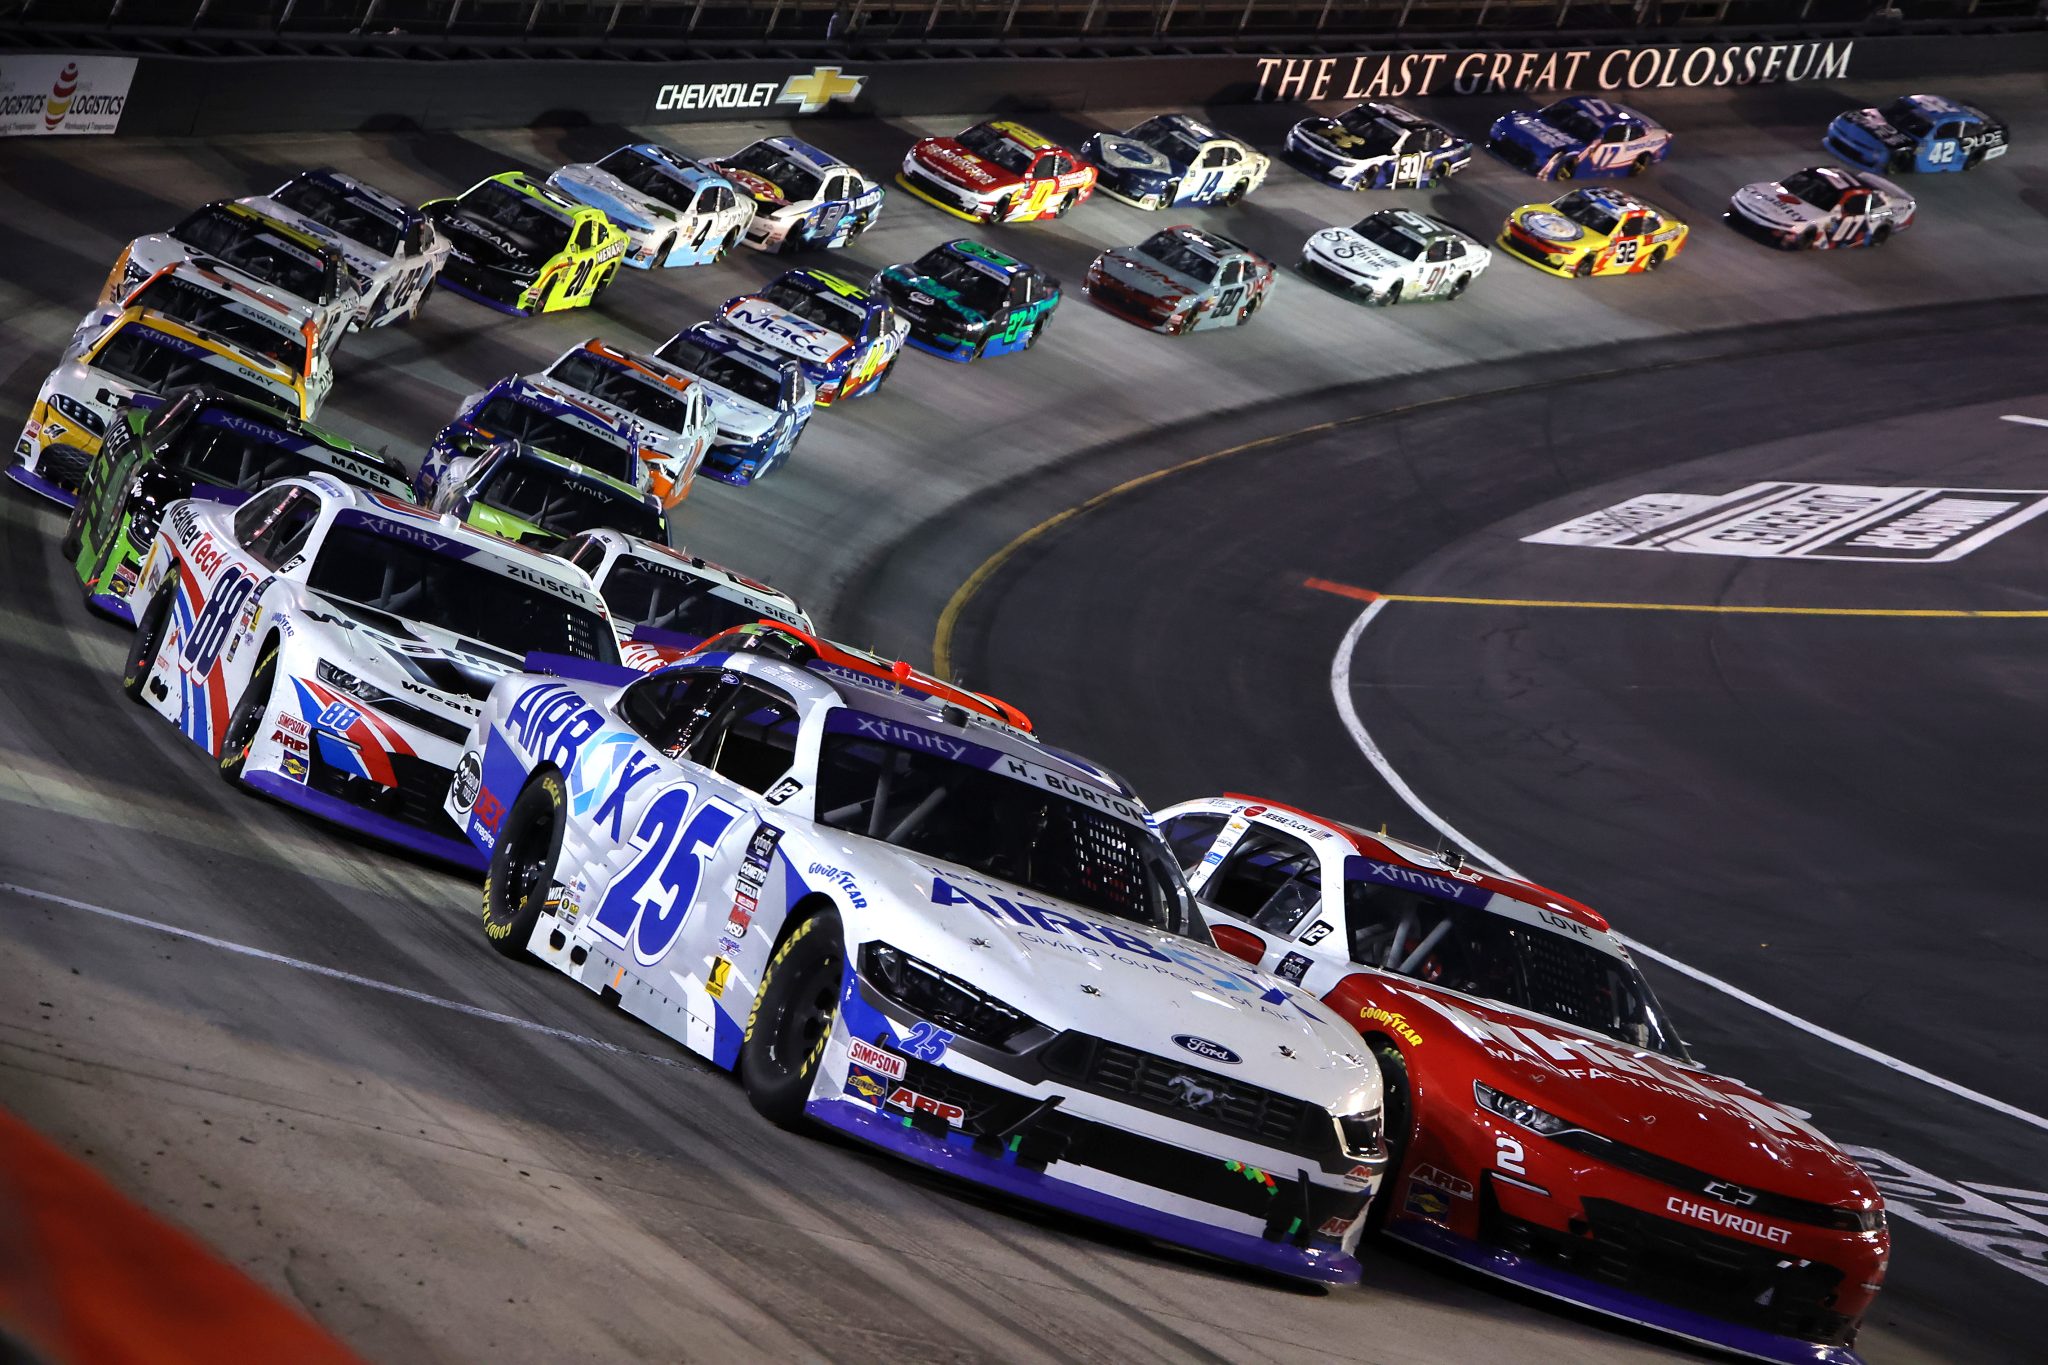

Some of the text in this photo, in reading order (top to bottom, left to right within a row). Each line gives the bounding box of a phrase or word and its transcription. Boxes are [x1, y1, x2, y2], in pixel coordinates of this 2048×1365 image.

[1254, 41, 1855, 103] THE LAST GREAT COLOSSEUM
[0, 95, 46, 115] OGISTICS
[69, 96, 124, 115] LOGISTICS
[656, 82, 778, 111] CHEVROLET
[1399, 153, 1421, 180] 31
[1597, 146, 1620, 167] 17
[1928, 141, 1956, 163] 42
[1191, 170, 1224, 204] 14
[443, 215, 530, 259] TUSCANY
[690, 218, 713, 254] 4
[1831, 214, 1866, 242] 07
[1615, 240, 1637, 265] 32
[168, 278, 219, 301] xfinity
[564, 257, 595, 298] 20
[1422, 265, 1446, 295] 91
[1210, 286, 1245, 319] 99
[241, 307, 297, 337] SAWALICH
[1003, 310, 1028, 344] 27
[137, 326, 196, 352] xfinity
[238, 366, 275, 386] GRAY
[510, 393, 552, 413] xfinity
[43, 423, 68, 440] 54
[219, 411, 290, 445] xfinity
[578, 419, 617, 443] KVAPIL
[331, 455, 391, 490] MAYER
[562, 478, 614, 504] xfinity
[169, 502, 228, 580] WeatherTech
[360, 515, 450, 551] xfinity
[508, 564, 586, 604] ZILISCH
[634, 557, 698, 585] xfinity
[184, 566, 255, 678] 88
[744, 597, 797, 625] R. SIEG
[279, 714, 308, 736] SIMPSON
[320, 703, 361, 731] 88
[271, 730, 309, 752] ARP
[857, 717, 968, 761] xfinity
[1007, 759, 1145, 822] H. BURTON
[473, 785, 506, 834] DEX
[1262, 812, 1316, 835] JESSE LOVE
[473, 818, 505, 849] imaging
[589, 784, 745, 964] 25
[807, 862, 868, 911] GOODYEAR
[1368, 862, 1464, 898] xfinity
[547, 886, 565, 901] WIX
[724, 920, 745, 938] MSD
[1538, 911, 1592, 940] LOVE
[1016, 930, 1100, 957] Giving
[1100, 949, 1148, 970] You
[1154, 964, 1228, 995] Peace
[1229, 992, 1254, 1007] of
[1360, 1006, 1424, 1047] GOODYEAR
[851, 1042, 900, 1076] SIMPSON
[898, 1021, 955, 1067] 25
[1187, 1037, 1230, 1060] Ford
[848, 1076, 883, 1096] SUNOCO
[1487, 1047, 1716, 1109] MANUFACTURED
[890, 1089, 962, 1121] ARP
[1495, 1136, 1526, 1176] 2
[1411, 1166, 1472, 1197] ARP
[1666, 1196, 1793, 1245] CHEVROLET
